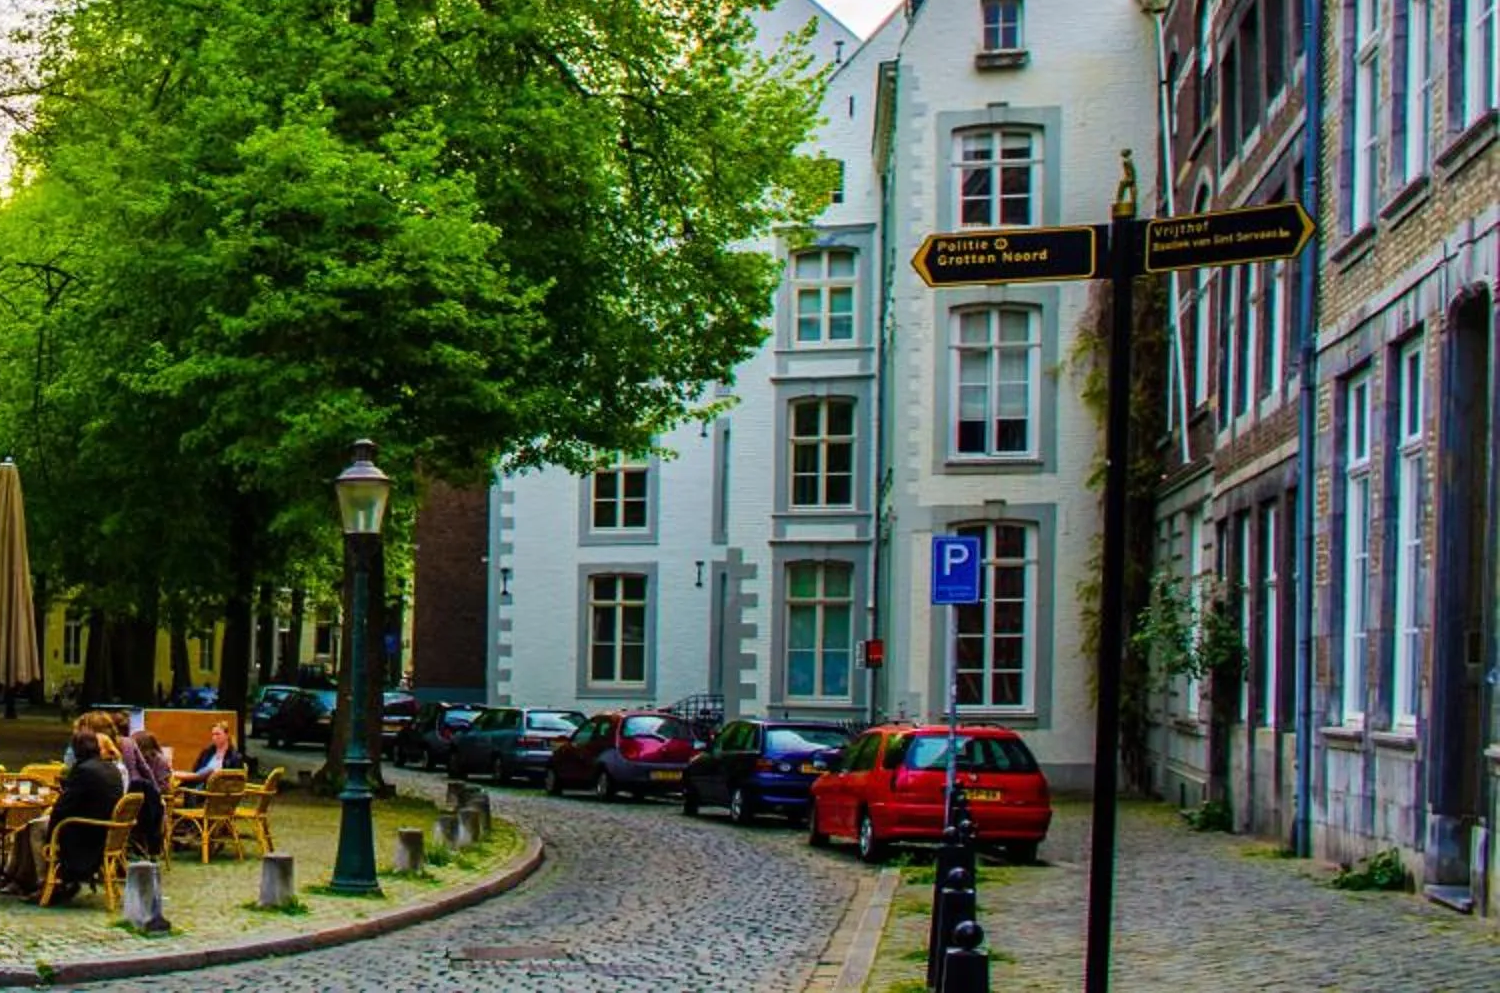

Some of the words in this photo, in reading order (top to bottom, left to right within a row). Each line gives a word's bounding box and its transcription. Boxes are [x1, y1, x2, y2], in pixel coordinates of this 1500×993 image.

[1153, 221, 1209, 238] Vrijthof
[937, 240, 988, 251] Politie
[937, 254, 996, 266] Grotten
[1002, 248, 1048, 262] Noord
[945, 544, 969, 576] P
